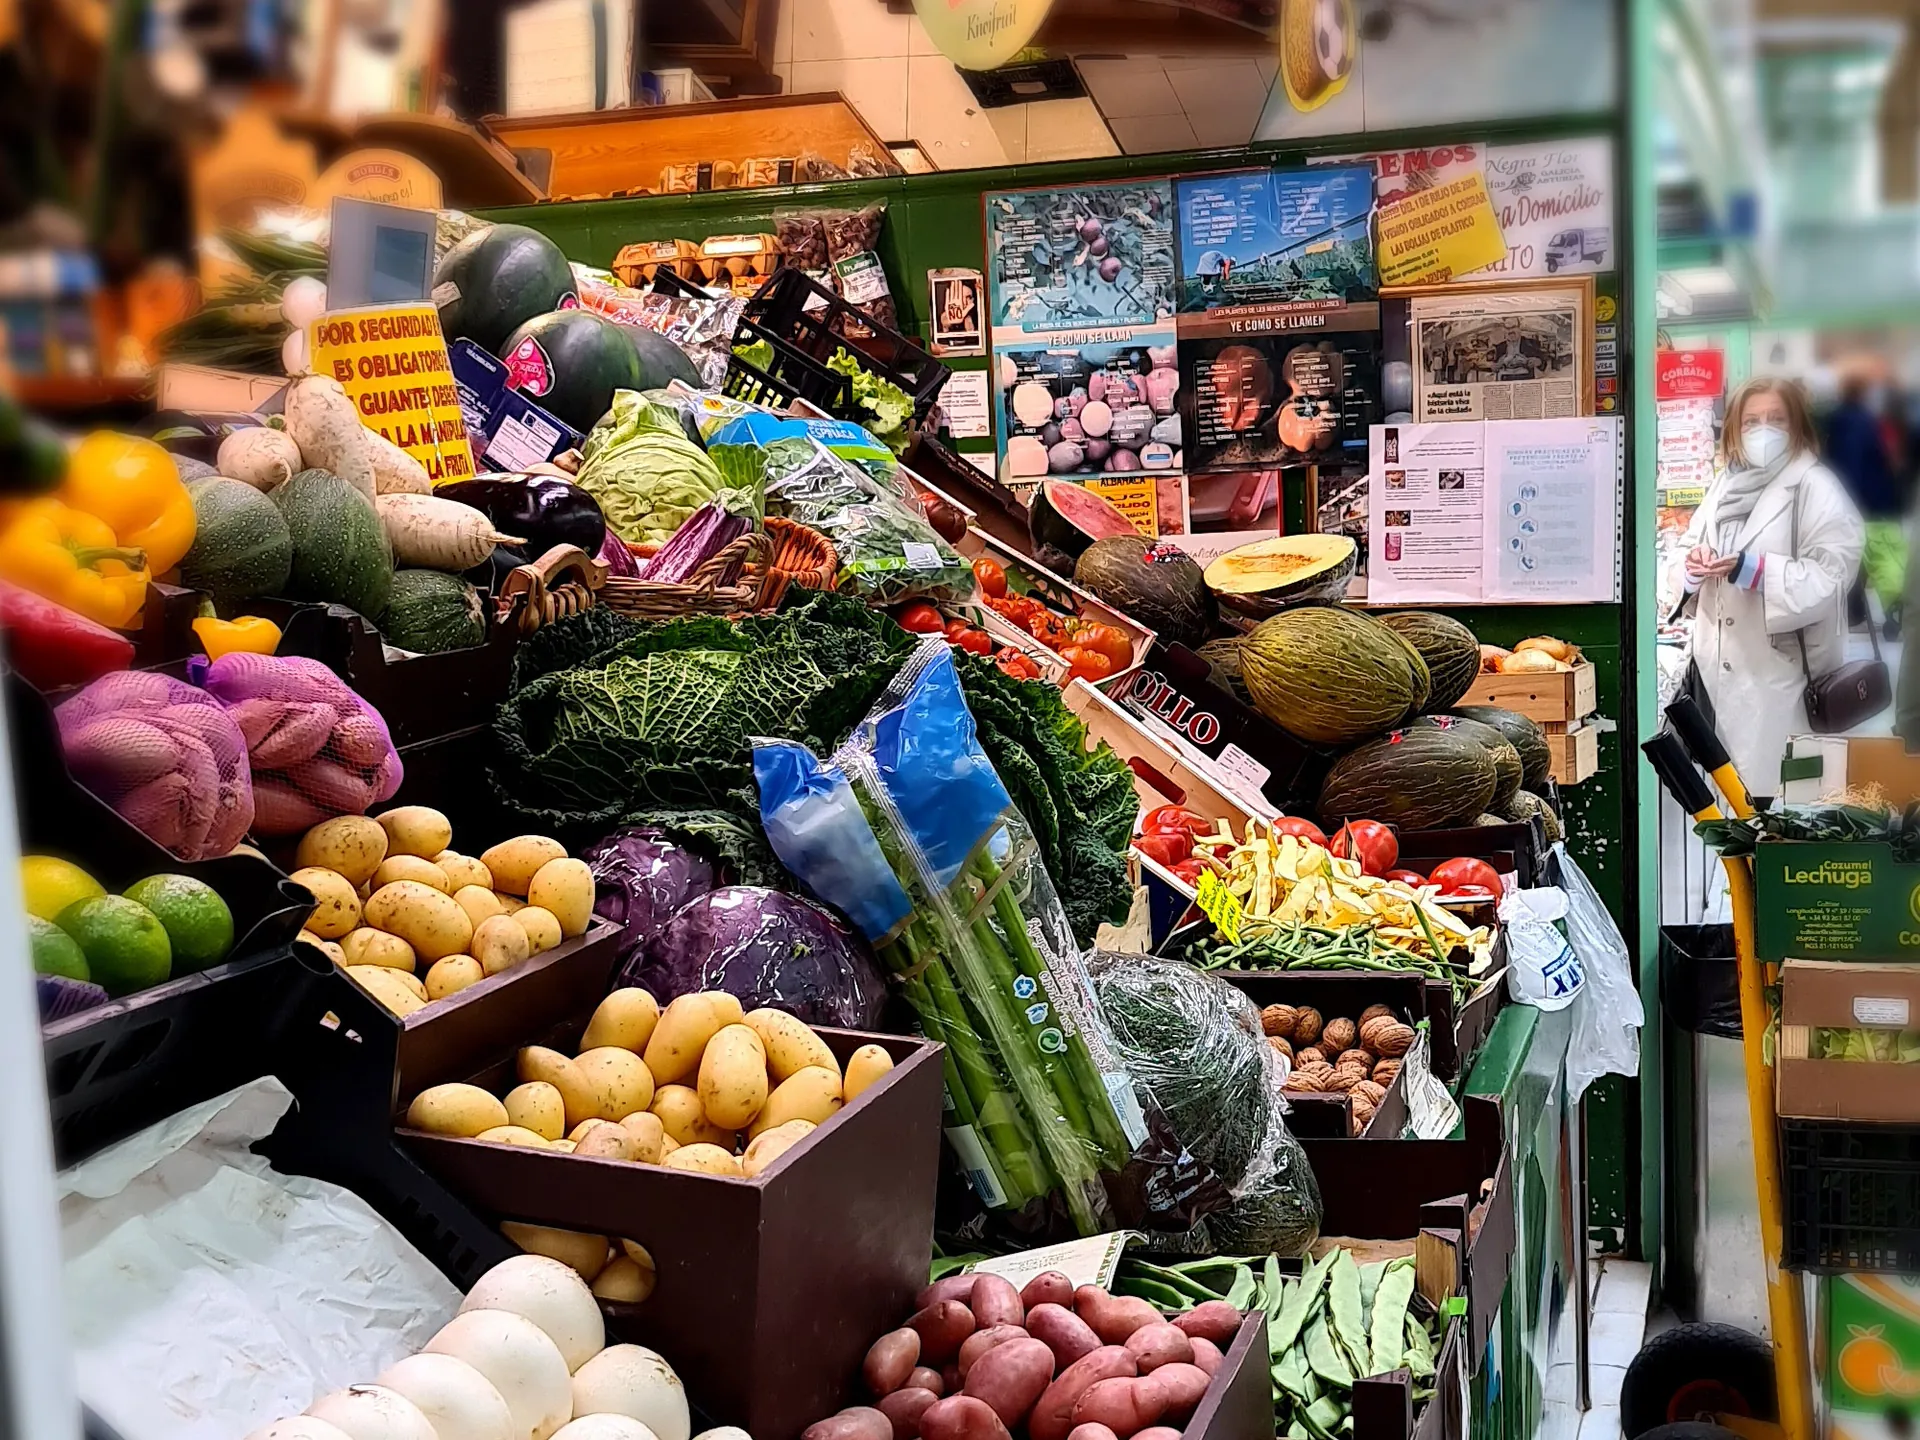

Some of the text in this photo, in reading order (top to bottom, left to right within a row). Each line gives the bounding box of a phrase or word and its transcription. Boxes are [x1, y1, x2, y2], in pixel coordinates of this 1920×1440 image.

[1378, 145, 1477, 179] EMOS
[1486, 157, 1536, 175] Negra
[1541, 168, 1581, 177] GALICIA
[1537, 174, 1585, 184] ASTURIAS
[1518, 183, 1603, 227] Domicilio
[1408, 207, 1450, 232] OBLIGADOS
[318, 321, 356, 347] POR
[359, 315, 432, 343] SEGURIDAD
[1230, 315, 1325, 333] YE COMO SE LLAMEN
[1048, 330, 1132, 346] YE COMO SE LLAMA
[333, 358, 354, 382] ES
[1662, 366, 1713, 382] CORBATAS
[360, 387, 430, 415] GUANTES
[1449, 390, 1463, 398] está
[396, 424, 419, 448] LA
[808, 426, 857, 440] ESPINACA
[426, 459, 444, 480] LA
[1824, 860, 1871, 870] Cozumel
[1784, 866, 1872, 888] Lechuga
[1026, 917, 1060, 971] Agrupación
